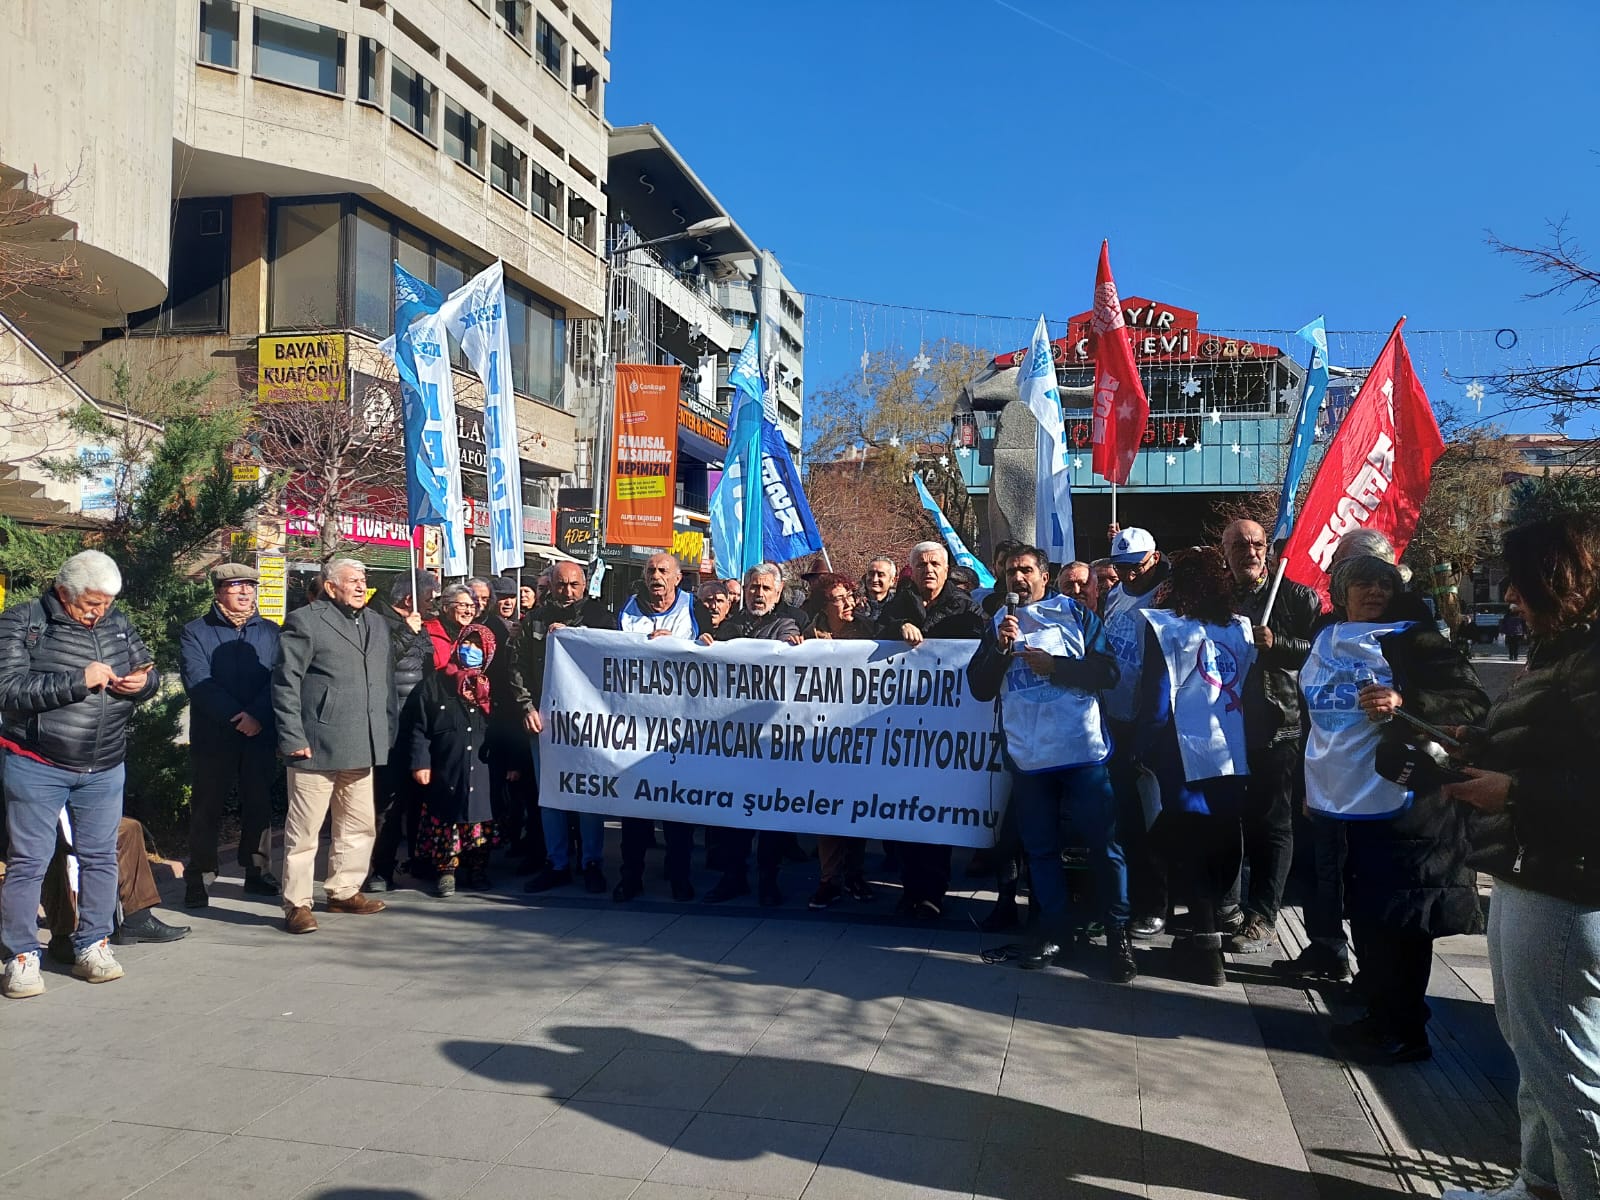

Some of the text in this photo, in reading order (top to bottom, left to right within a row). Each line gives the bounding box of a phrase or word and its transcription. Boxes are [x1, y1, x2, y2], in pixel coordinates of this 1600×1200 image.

[1126, 302, 1174, 330] YİR
[275, 341, 328, 359] BAYAN
[264, 359, 340, 383] KUAFÖRÜ
[687, 397, 712, 420] MERAM
[618, 432, 665, 449] FİNANSAL
[617, 447, 673, 463] BAŞARIMIZ
[617, 461, 670, 477] HEPİMİZİN
[569, 516, 591, 524] KURU
[603, 657, 963, 708] ENFLASYON FARKI ZAM DEĞİLDİR!
[1304, 684, 1362, 710] KES
[550, 700, 1002, 773] İNSANCA YAŞAYACAK BİR ÜCRET İSTİYORUZ
[559, 771, 1000, 829] KESK Ankara şubeler platformu
